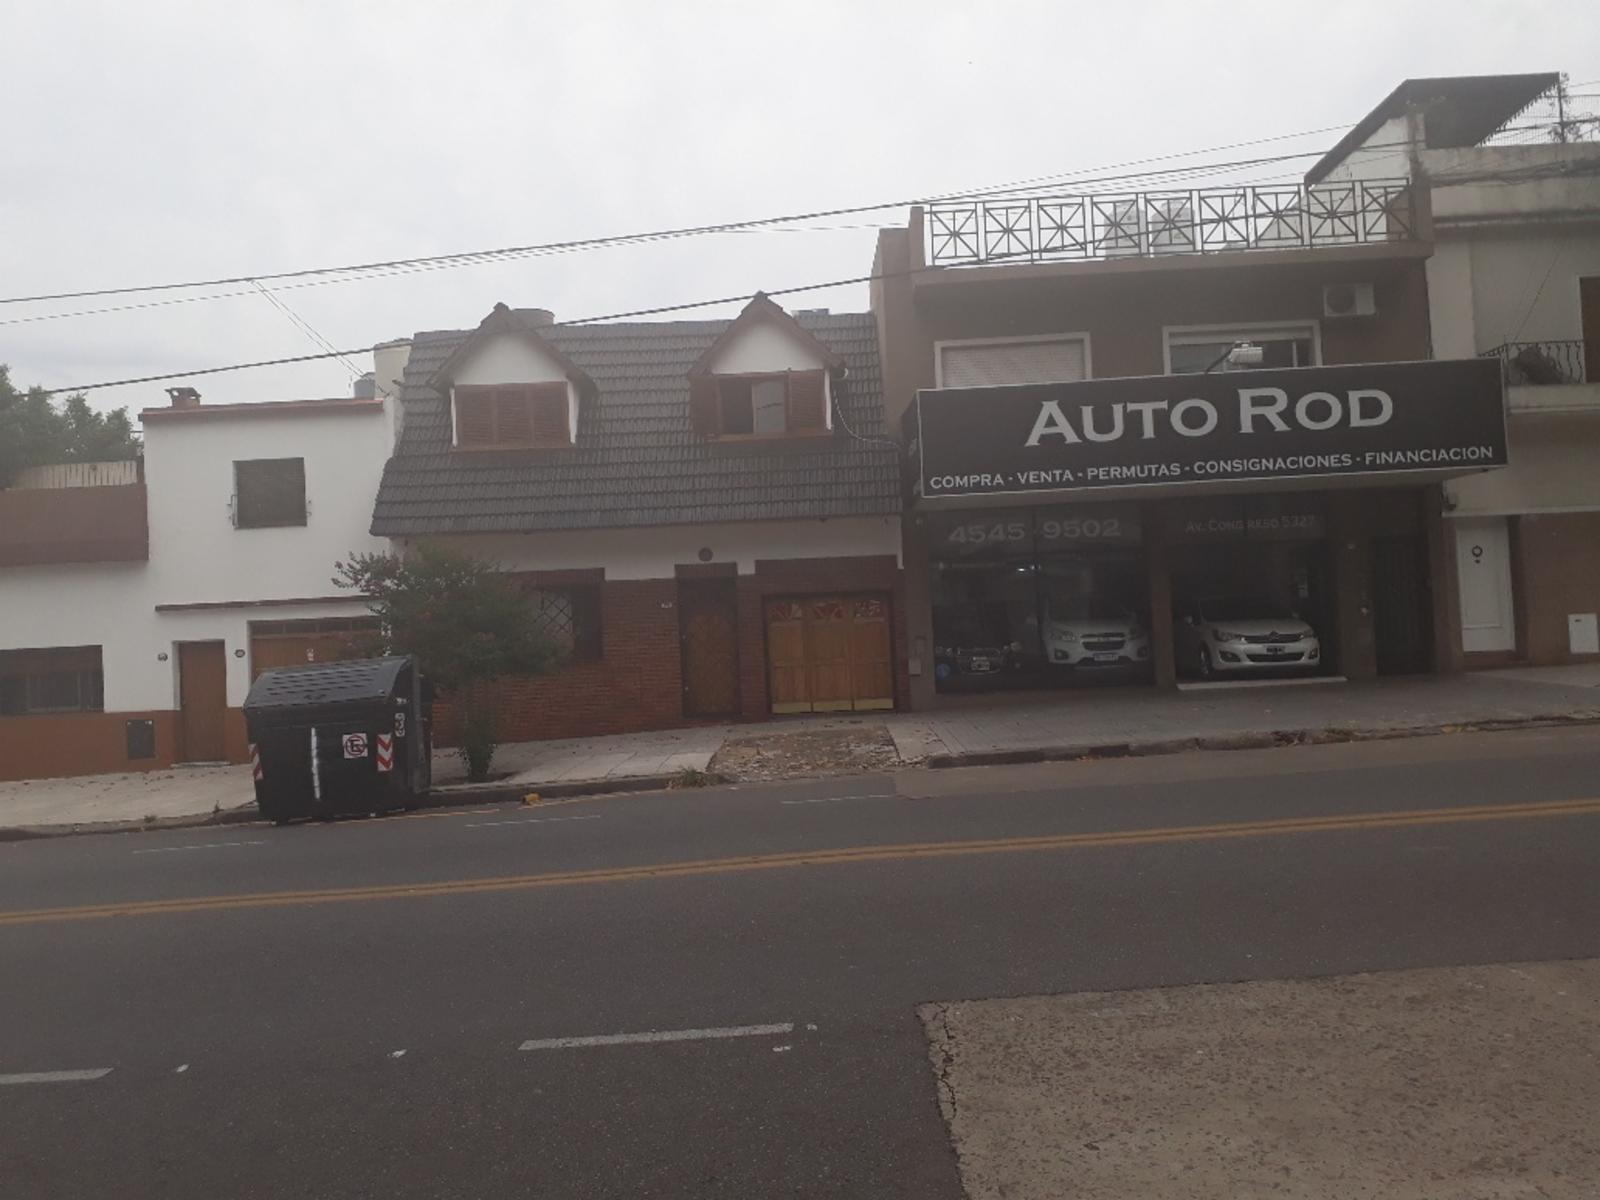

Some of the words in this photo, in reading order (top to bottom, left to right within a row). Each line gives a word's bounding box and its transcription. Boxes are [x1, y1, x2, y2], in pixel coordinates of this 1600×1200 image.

[1024, 398, 1219, 447] AUTO
[1237, 387, 1393, 434] ROD
[929, 473, 1005, 490] COMPRA
[1016, 469, 1075, 486] VENTA
[1086, 462, 1181, 481] PERMUTAS
[1193, 453, 1353, 475] CONSIGNACIONES
[1364, 446, 1494, 466] FINANCIACION
[947, 522, 1027, 544] 4545
[1042, 517, 1122, 539] 9502
